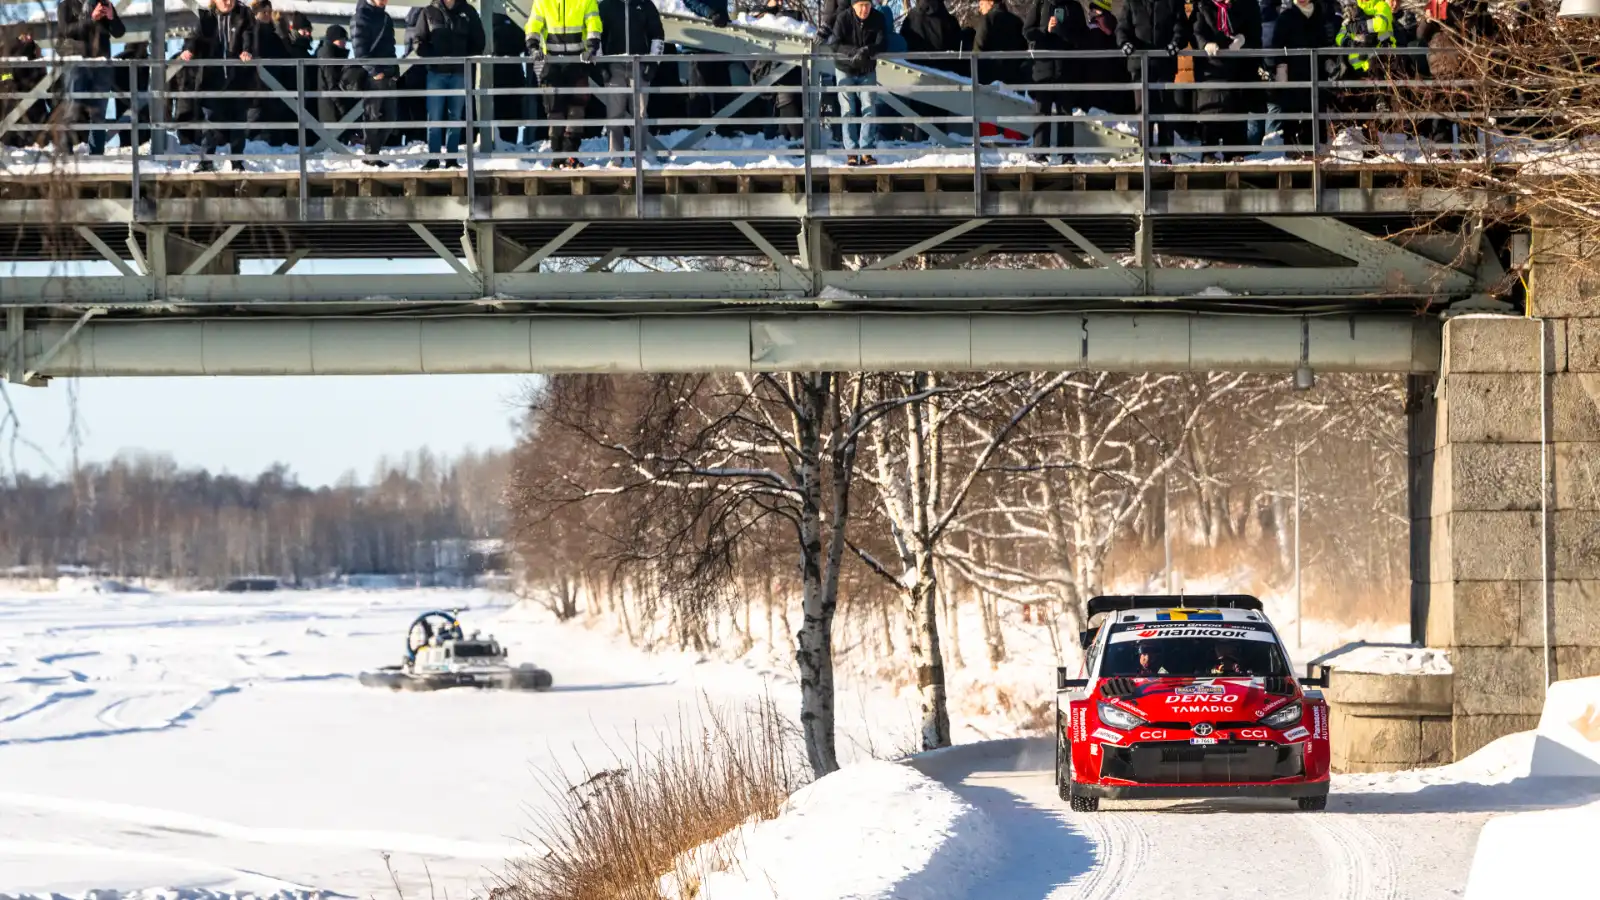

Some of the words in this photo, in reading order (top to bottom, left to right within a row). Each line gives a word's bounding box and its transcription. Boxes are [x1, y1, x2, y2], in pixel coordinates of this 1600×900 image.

[1165, 694, 1239, 704] DENSO
[1171, 705, 1233, 713] TAMADIC
[1072, 707, 1080, 744] AUTOMOTIVE
[1080, 707, 1088, 742] Panasonic
[1140, 730, 1167, 739] CCI
[1241, 729, 1268, 738] CCI
